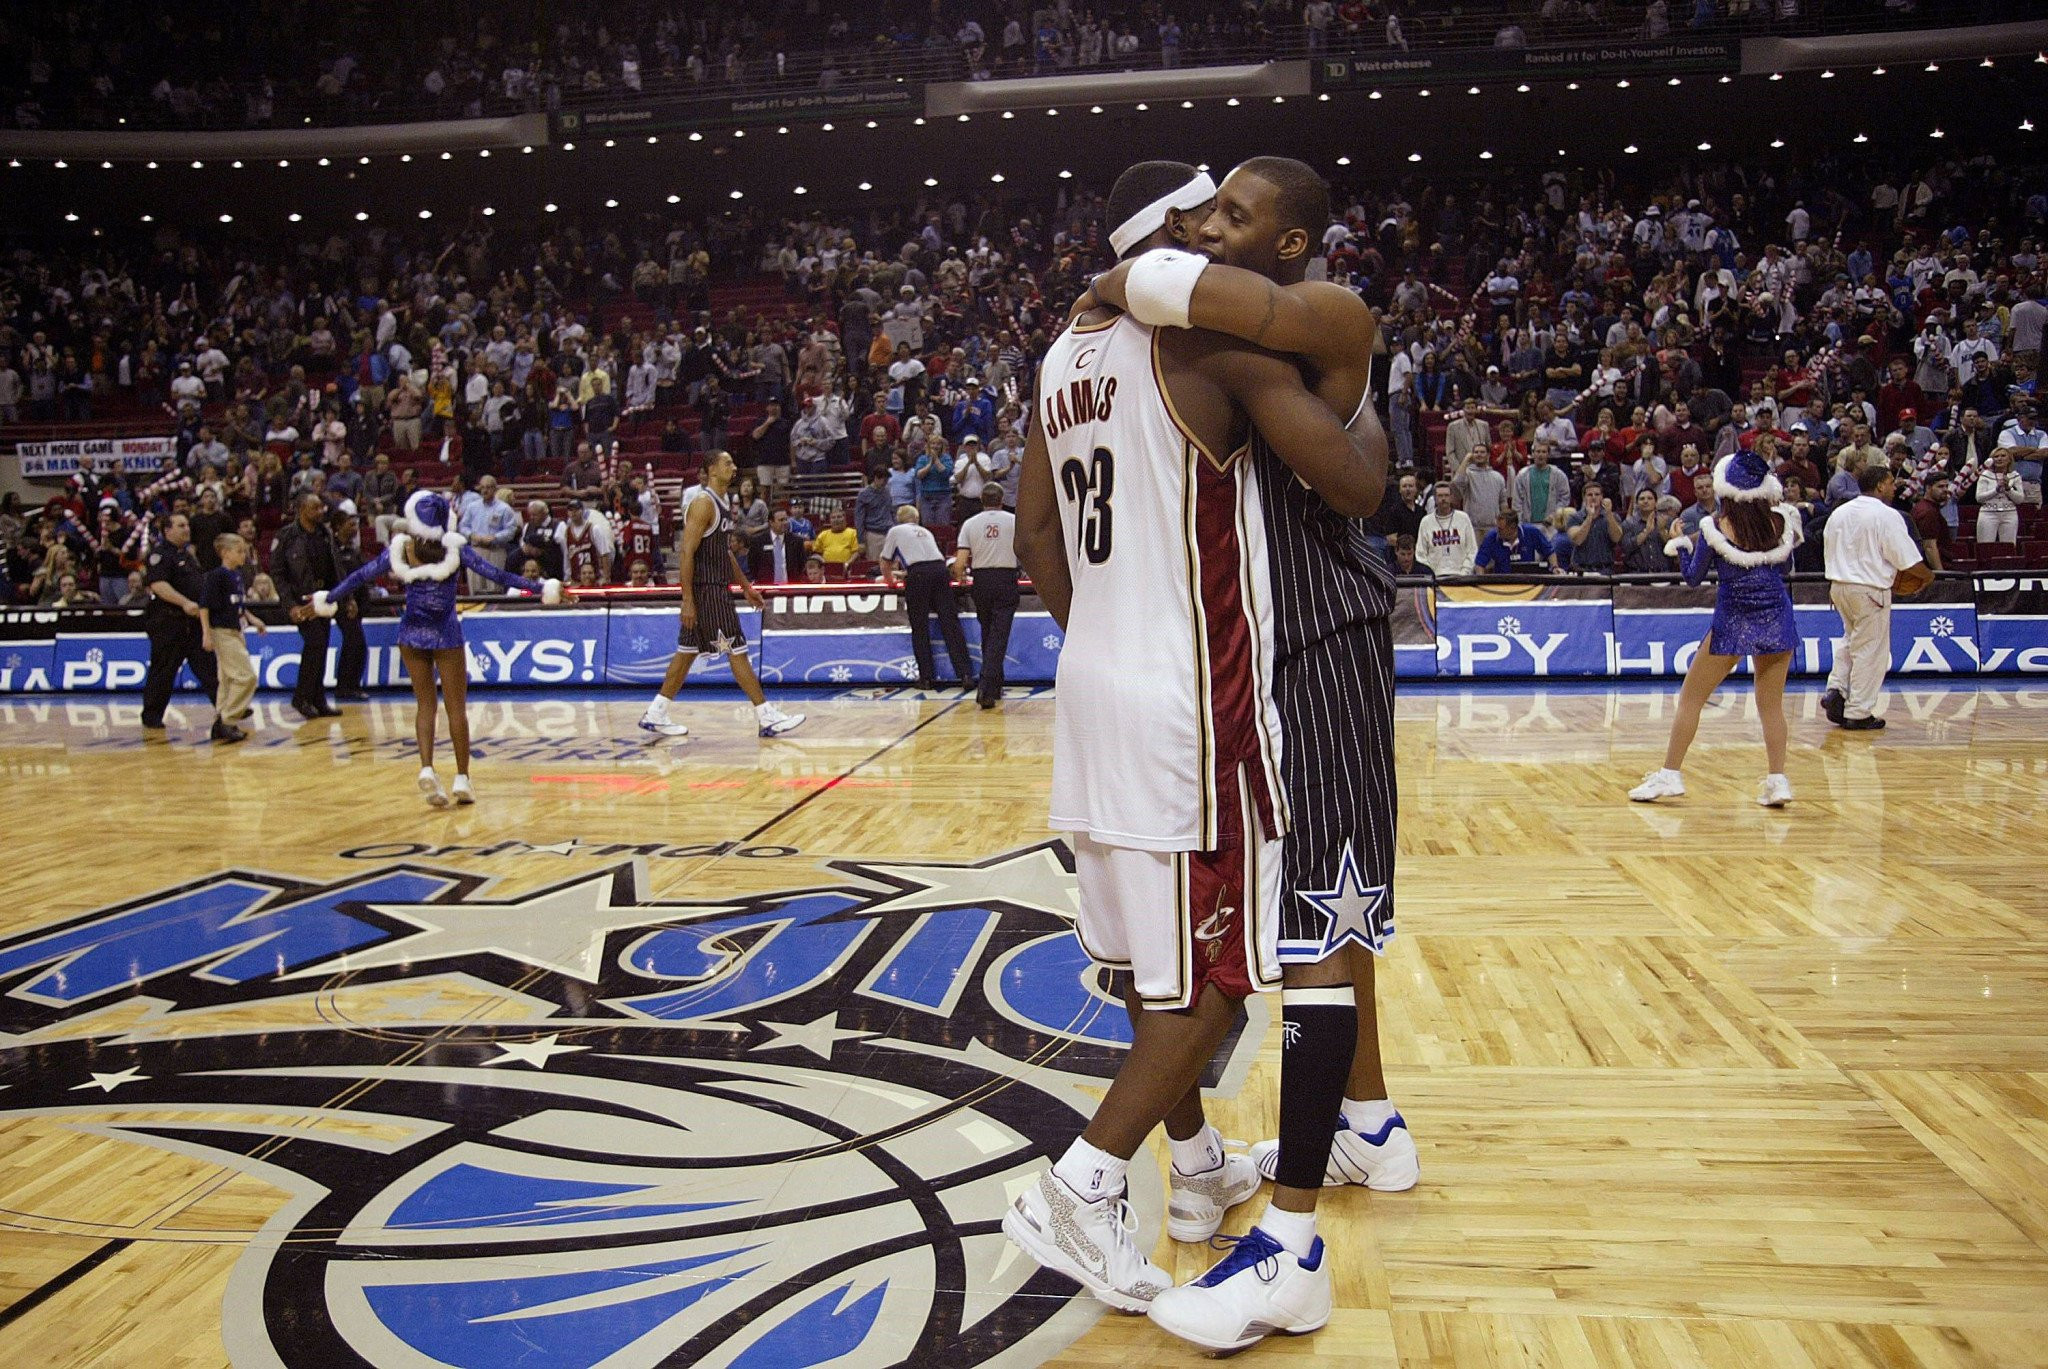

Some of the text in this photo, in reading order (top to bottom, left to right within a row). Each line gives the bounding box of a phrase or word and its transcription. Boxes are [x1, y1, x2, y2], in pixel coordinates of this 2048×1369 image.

[1525, 51, 1564, 64] Ranked
[1355, 59, 1432, 72] Waterhouse
[21, 444, 47, 457] NEXT
[51, 442, 80, 455] HOME
[83, 440, 113, 454] GAME
[122, 442, 162, 454] MONDAY
[986, 525, 999, 538] 26
